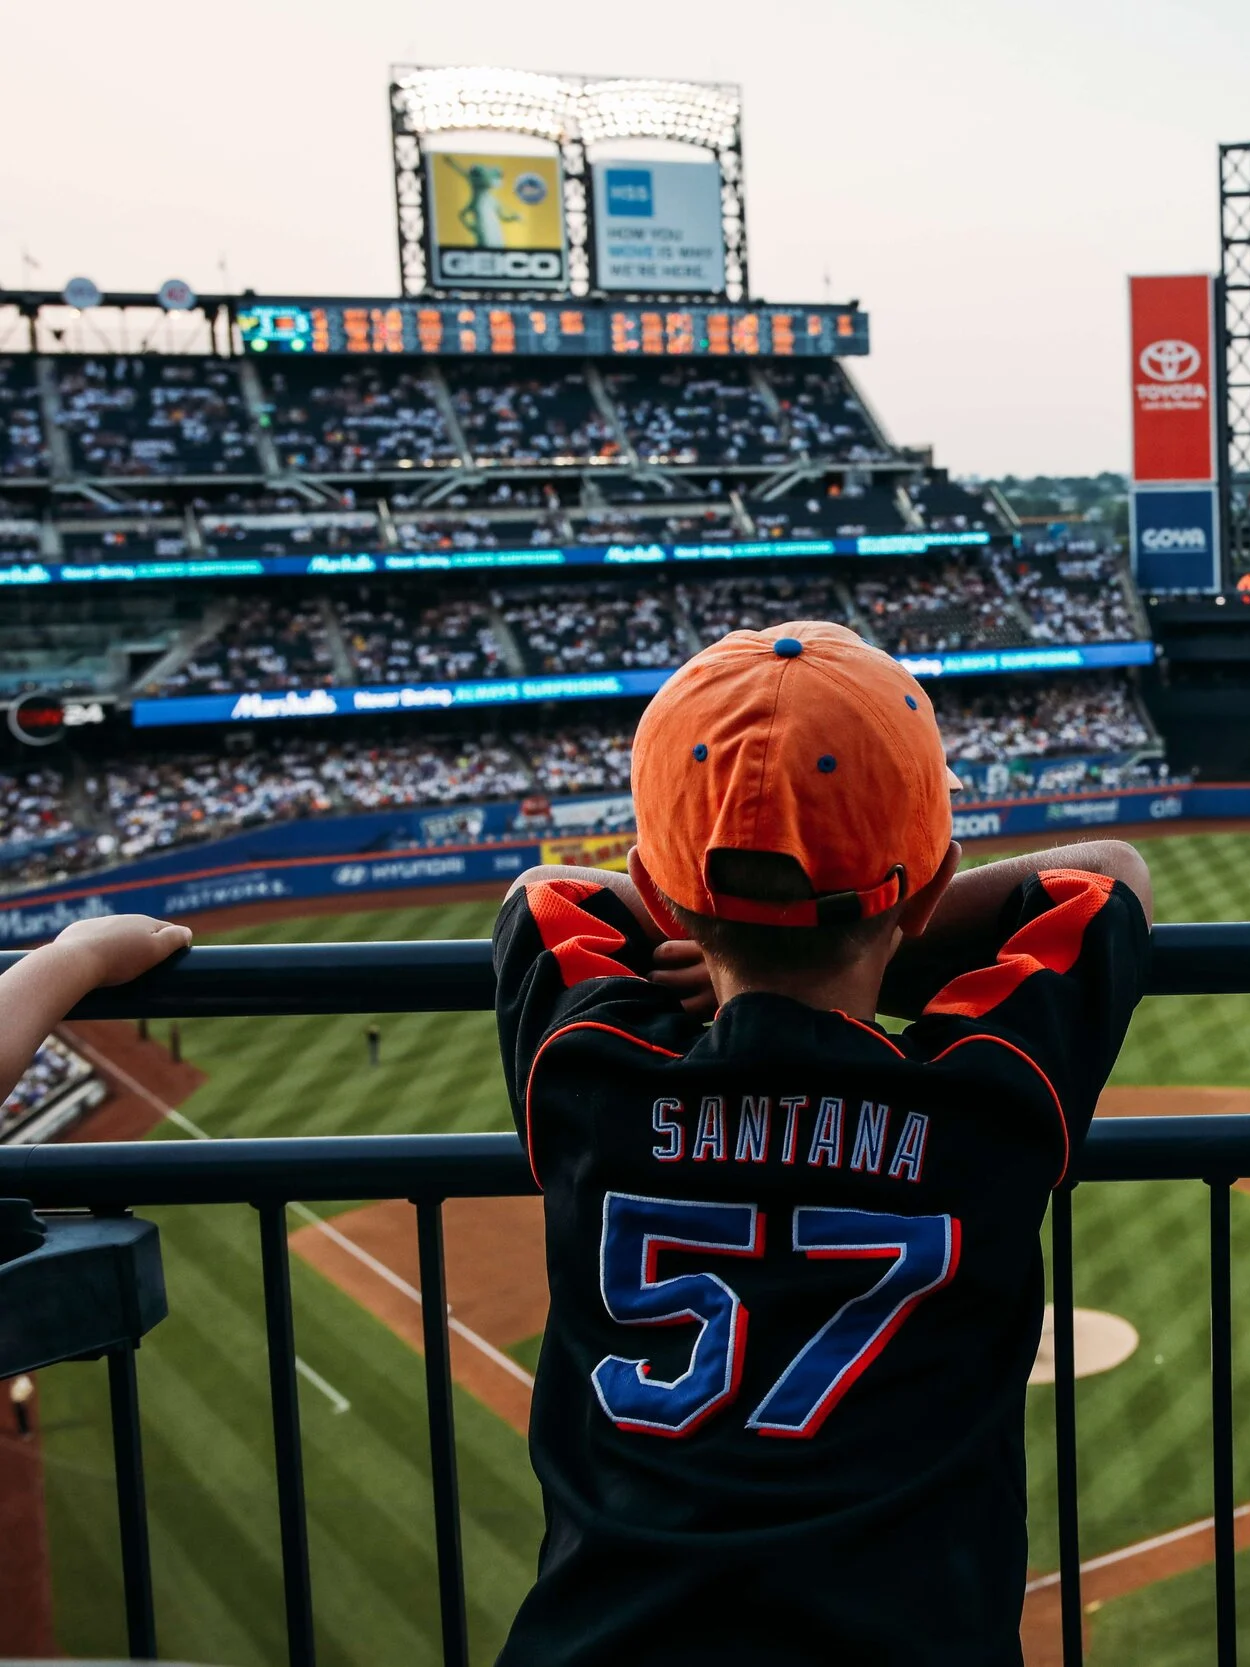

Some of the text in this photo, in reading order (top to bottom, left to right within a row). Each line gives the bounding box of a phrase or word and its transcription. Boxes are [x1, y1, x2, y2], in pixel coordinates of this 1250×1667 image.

[610, 184, 648, 197] HSS
[607, 227, 684, 242] HOW YOU
[607, 245, 714, 260] MOVE IS WHY
[441, 251, 562, 279] GEICO
[1137, 384, 1206, 401] TOYOTA
[1141, 528, 1206, 547] GOYA
[231, 689, 338, 719] Marshalls
[454, 681, 519, 704] ALWAYS
[371, 856, 465, 880] HYUNDAI
[651, 1095, 931, 1183] SANTANA
[590, 1190, 963, 1440] 57
